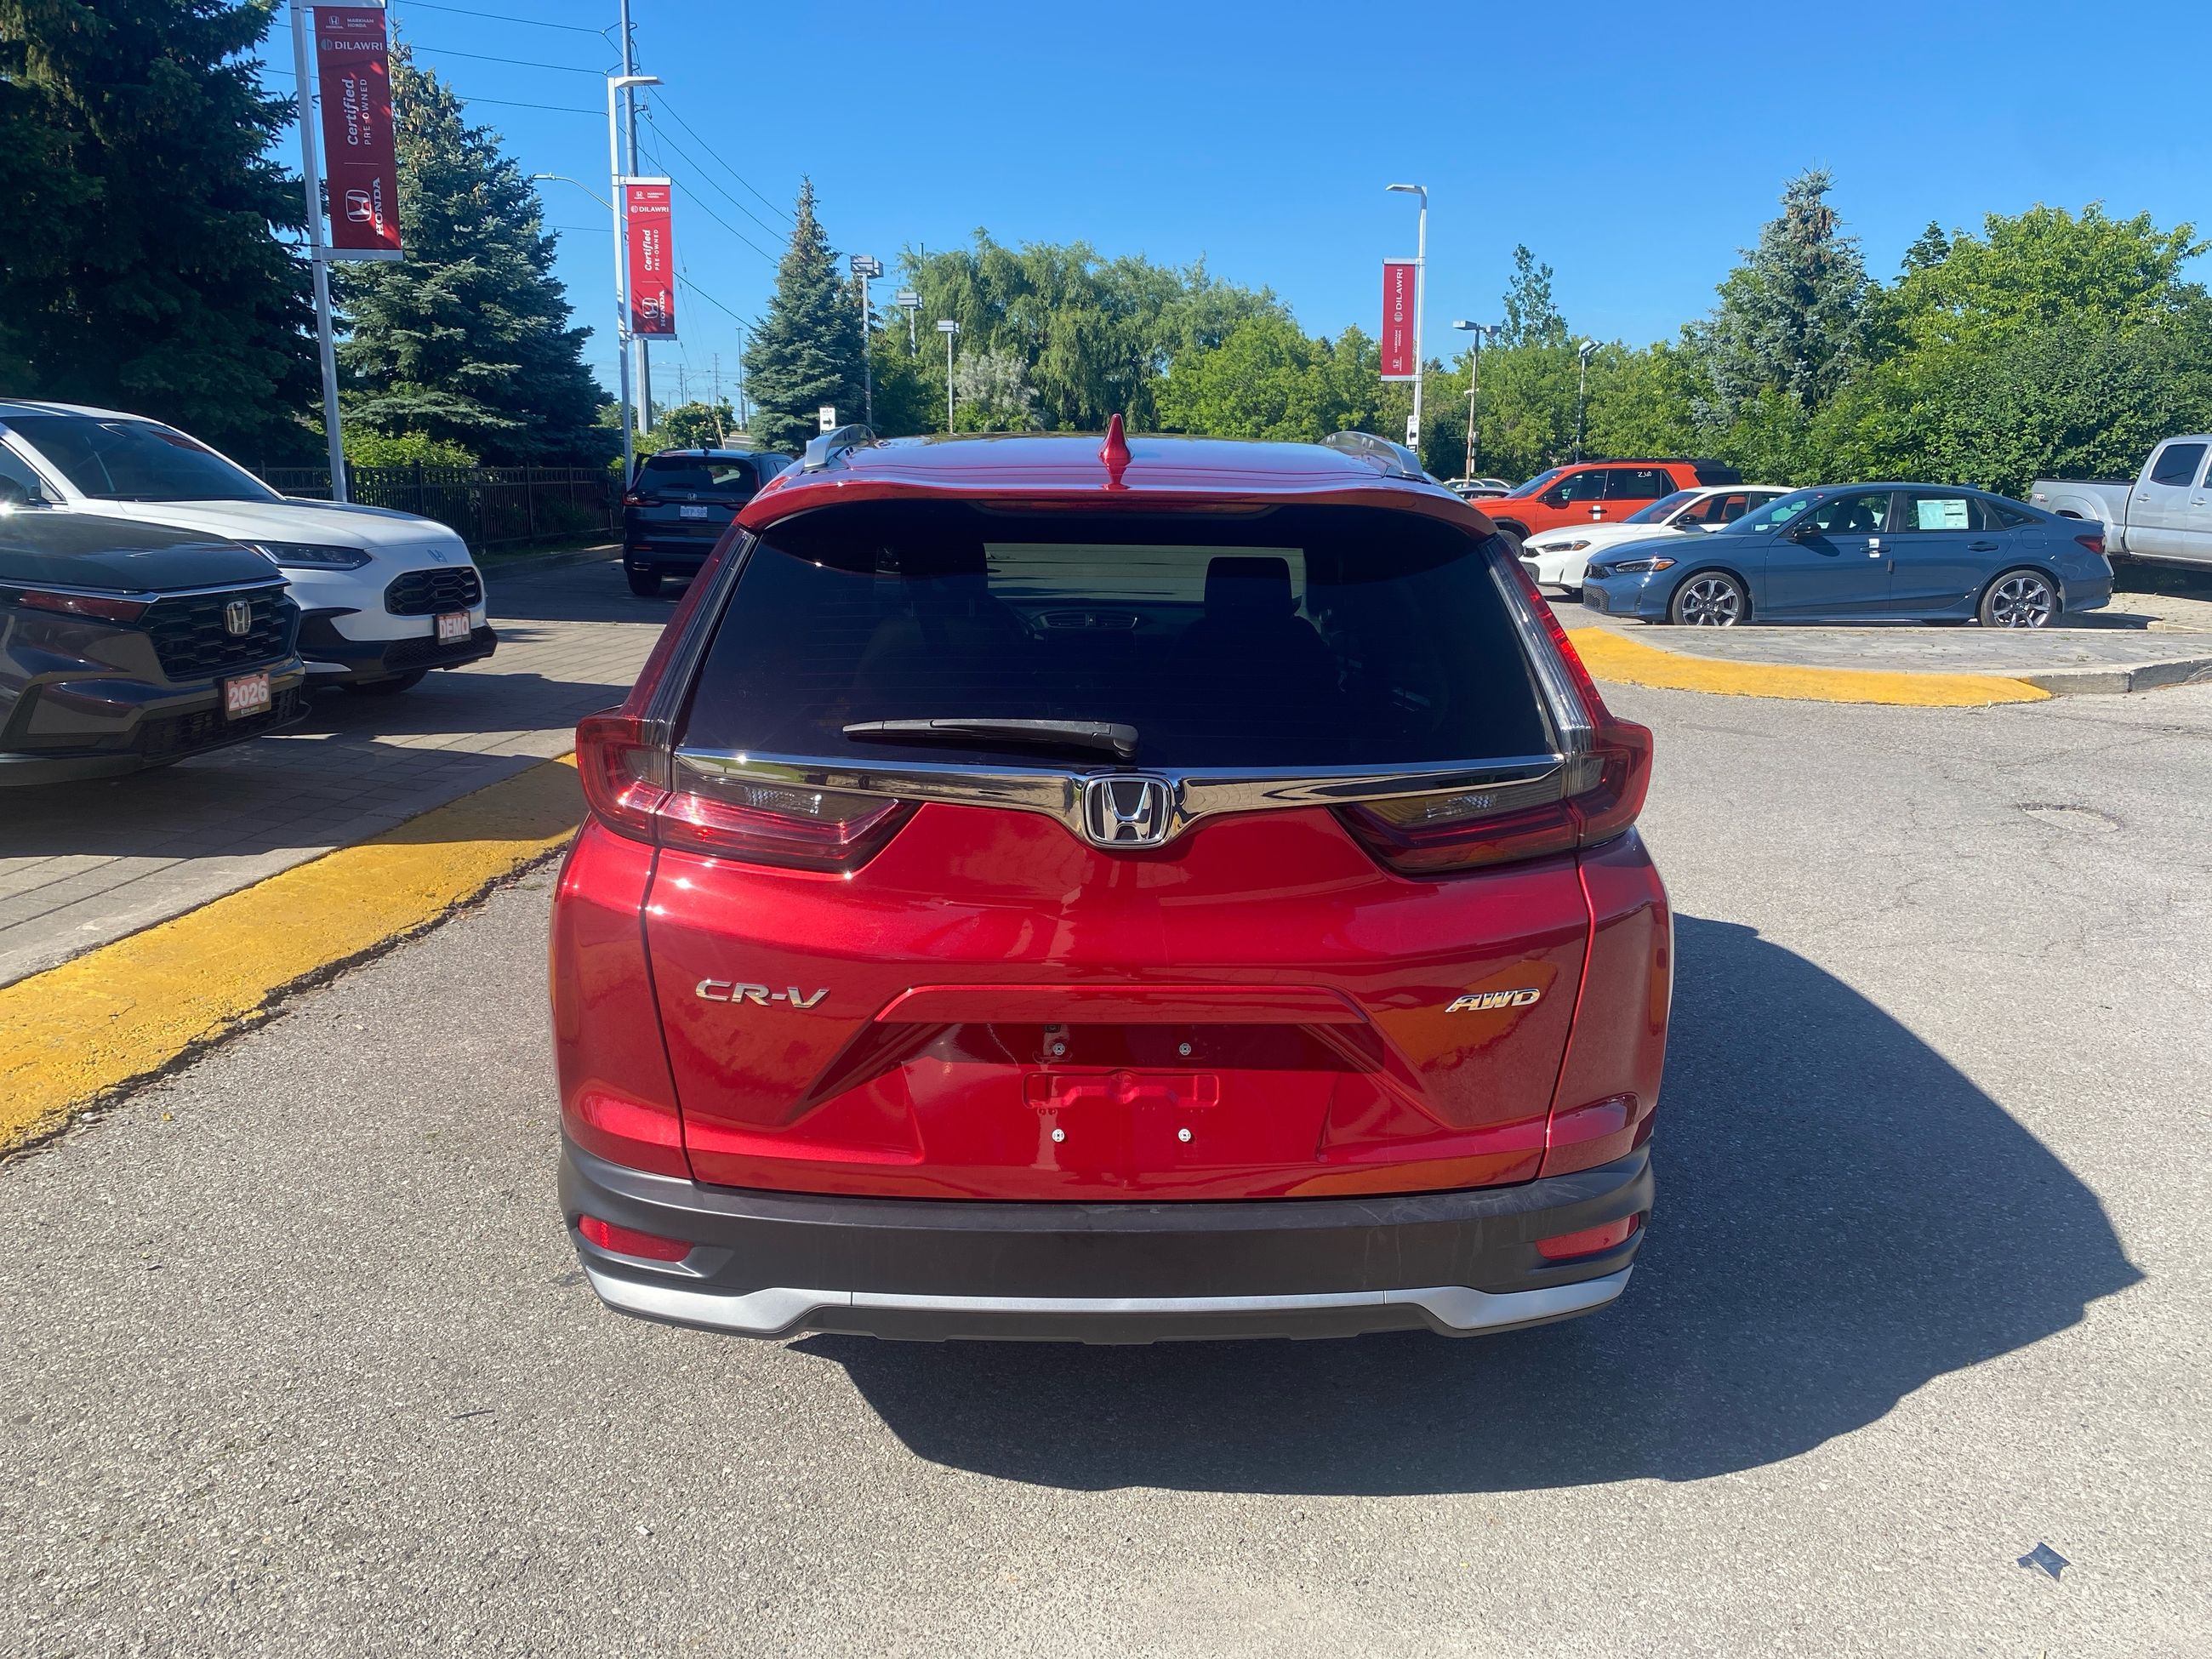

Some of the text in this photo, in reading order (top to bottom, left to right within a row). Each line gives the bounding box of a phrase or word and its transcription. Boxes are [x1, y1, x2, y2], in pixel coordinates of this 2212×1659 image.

[334, 41, 383, 51] DILAWRI
[342, 78, 359, 145] Certified
[360, 79, 372, 145] PRE-OWNED
[373, 176, 385, 237] HONDA
[642, 229, 653, 271] Certified
[1395, 268, 1404, 311] DILAWRI
[438, 617, 470, 639] DEMO
[228, 680, 268, 709] 2026
[695, 978, 831, 1008] CR-V
[1445, 988, 1541, 1013] AWD
